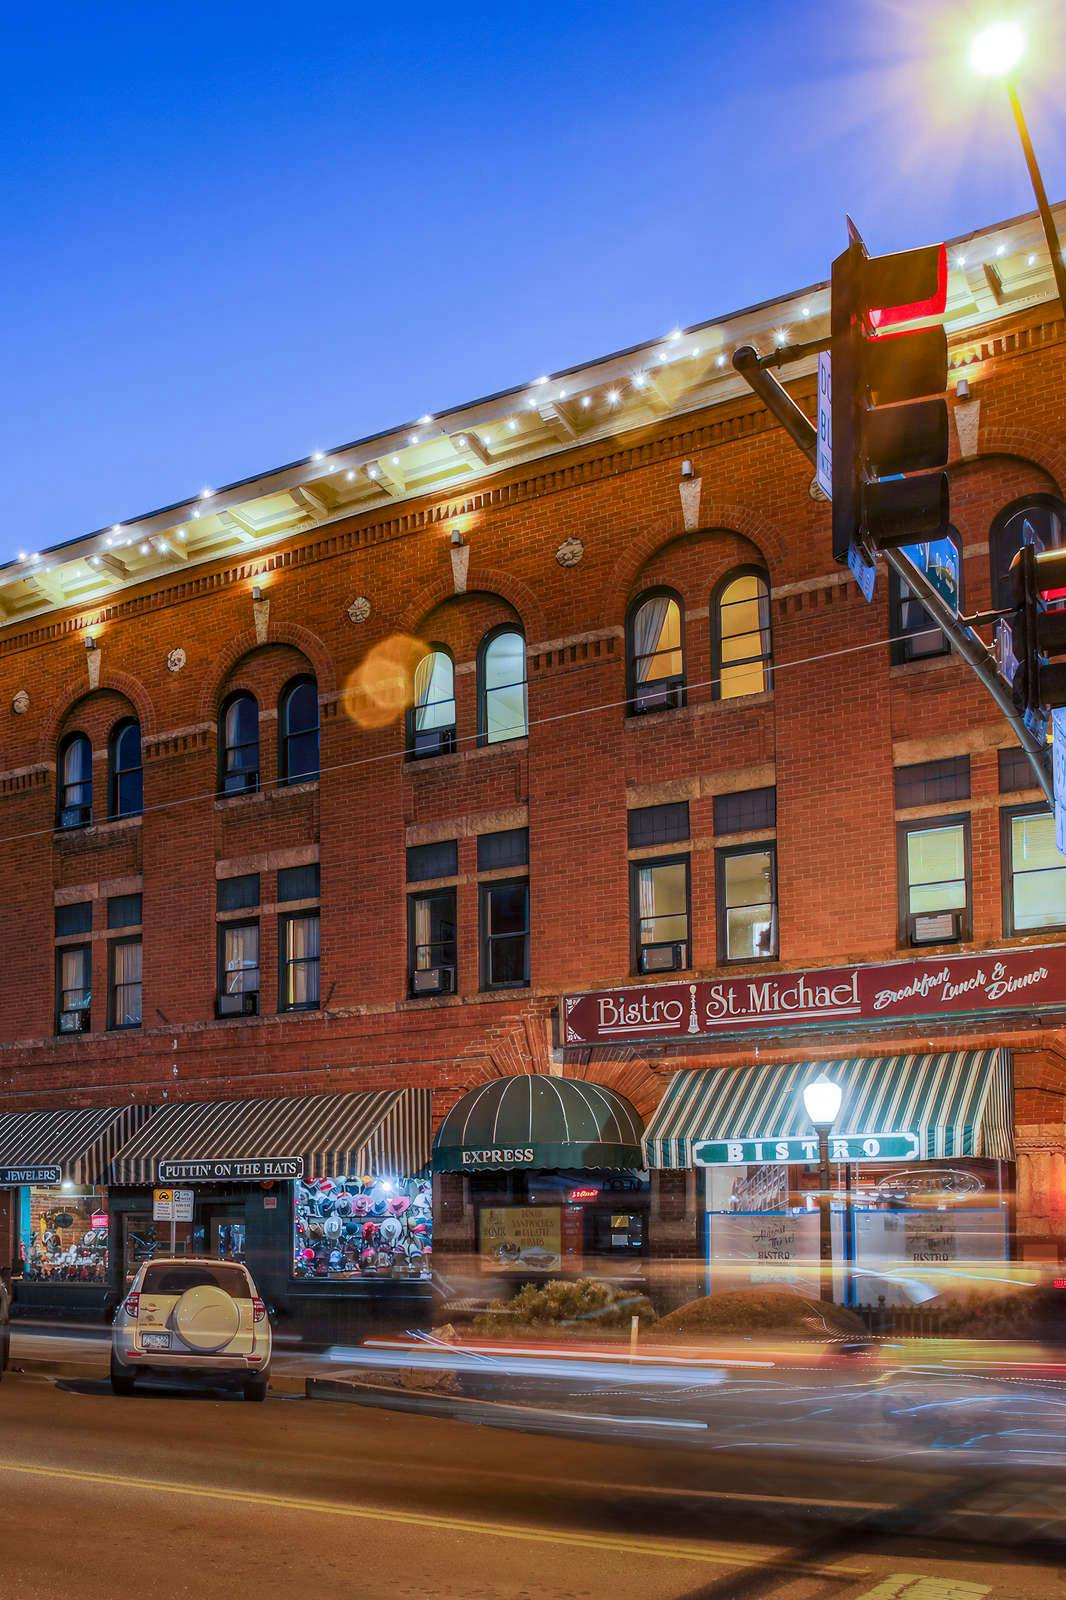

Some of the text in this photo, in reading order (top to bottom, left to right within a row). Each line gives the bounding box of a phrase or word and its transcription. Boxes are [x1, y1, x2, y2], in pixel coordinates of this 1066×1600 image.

[873, 967, 951, 1010] Breakfast
[941, 961, 1007, 1001] Lunch &
[984, 967, 1048, 1000] Dinner
[597, 995, 683, 1026] Bistro
[462, 1148, 534, 1164] EXPRESS
[727, 1138, 880, 1162] BISTRO
[5, 1170, 56, 1181] JEWELERS
[166, 1162, 297, 1177] PUTTIN' ON THE HATS
